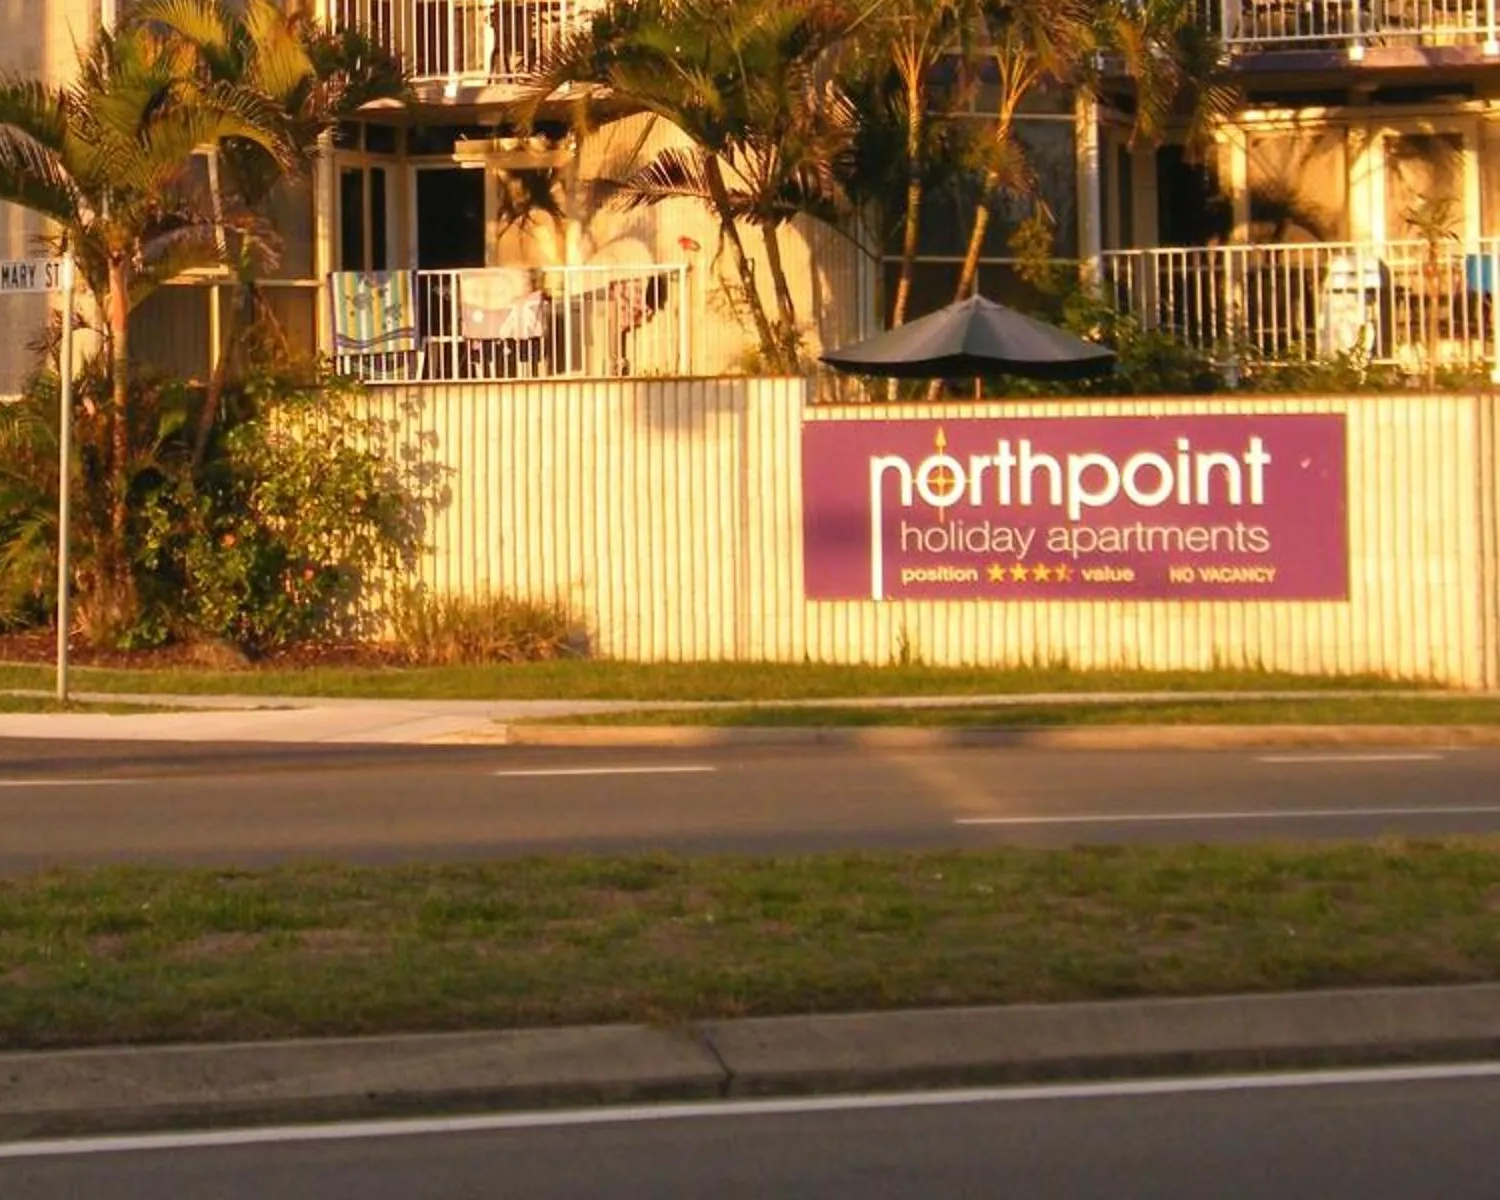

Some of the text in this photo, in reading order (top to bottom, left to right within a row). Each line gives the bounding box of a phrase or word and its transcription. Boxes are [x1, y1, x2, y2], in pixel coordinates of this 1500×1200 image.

[1, 263, 60, 289] MARY ST
[870, 436, 1272, 600] northpoint
[901, 520, 1270, 560] holiday apartments
[901, 565, 1135, 584] position value
[1169, 566, 1276, 583] NO VACANCY
